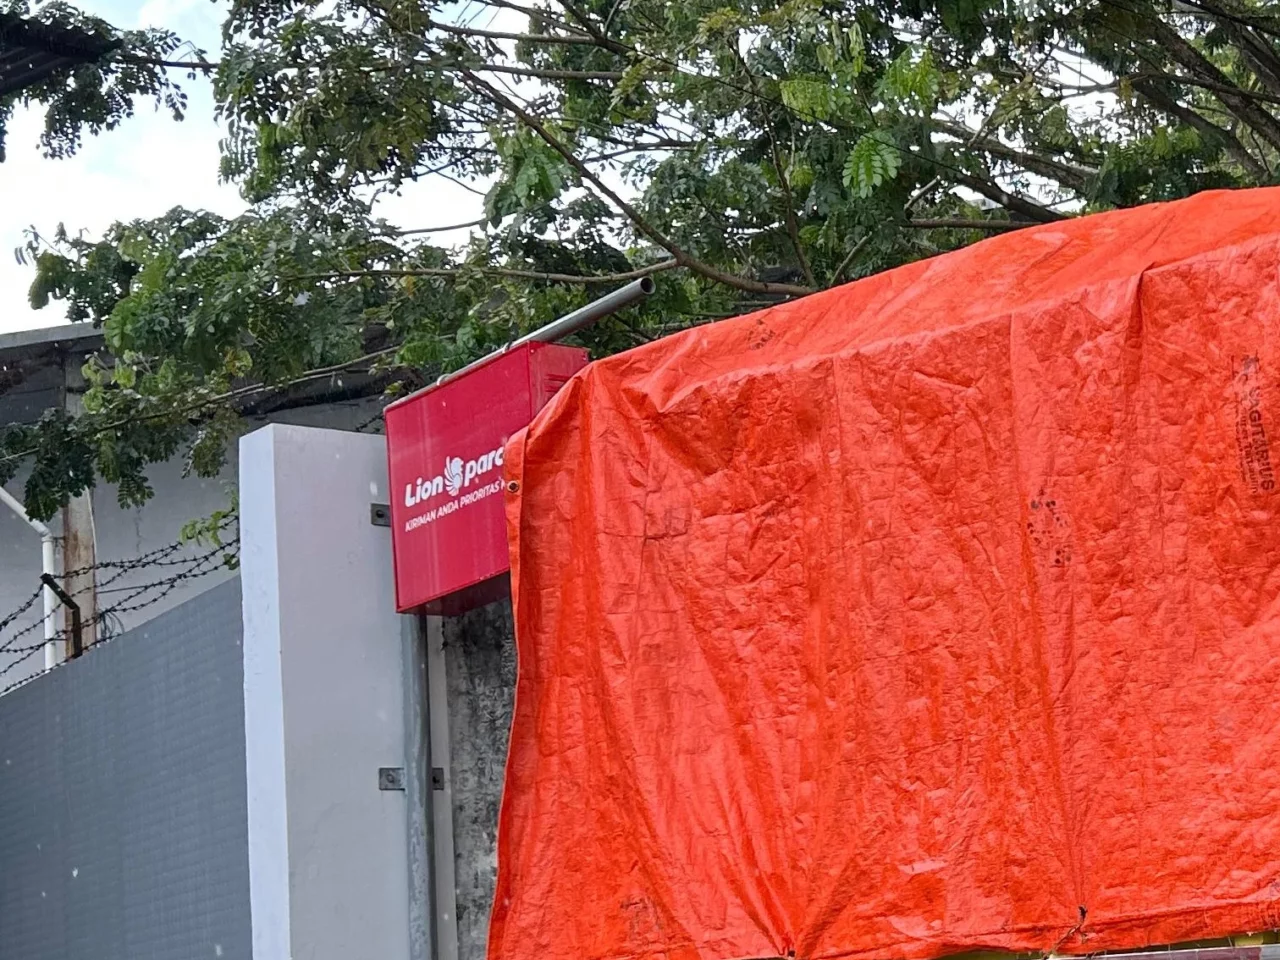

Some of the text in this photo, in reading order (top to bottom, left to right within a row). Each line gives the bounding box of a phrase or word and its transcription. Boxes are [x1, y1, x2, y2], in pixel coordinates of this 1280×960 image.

[405, 477, 443, 508] Lion
[405, 510, 437, 533] KIRIMAN
[437, 500, 459, 518] ANDA
[460, 480, 500, 508] PRIORITAS
